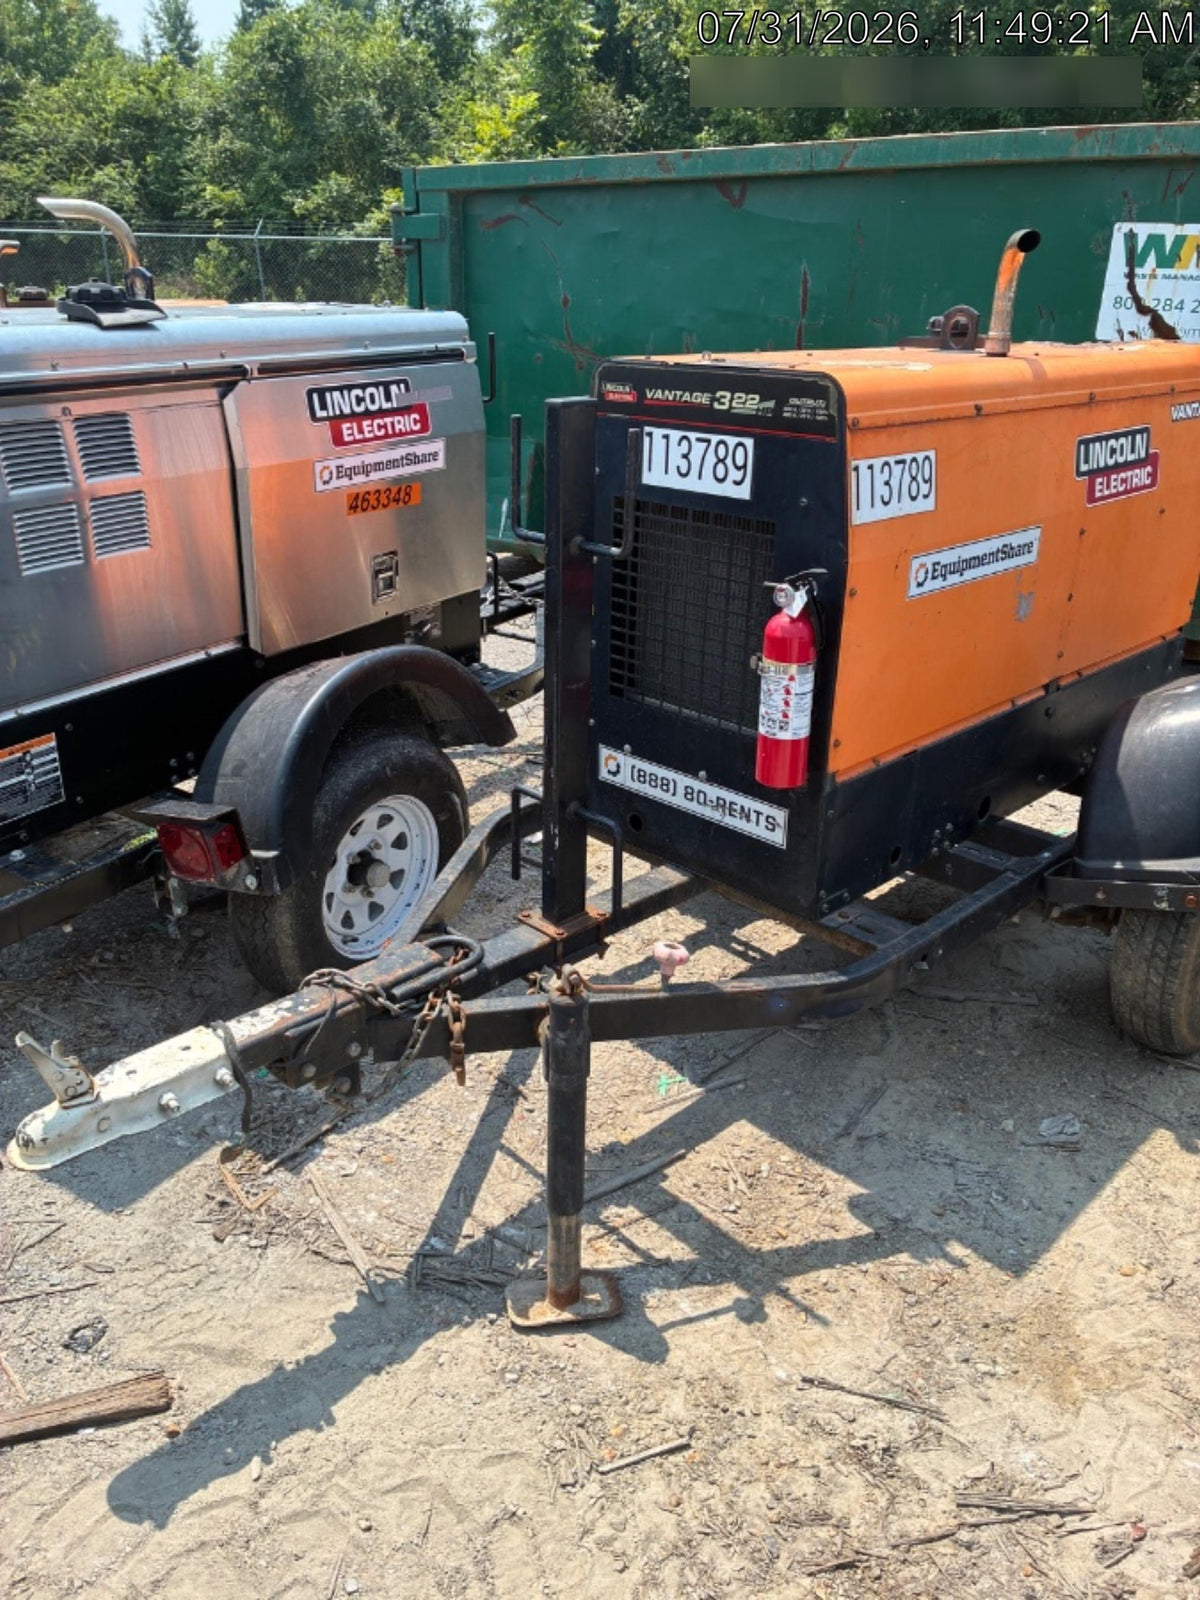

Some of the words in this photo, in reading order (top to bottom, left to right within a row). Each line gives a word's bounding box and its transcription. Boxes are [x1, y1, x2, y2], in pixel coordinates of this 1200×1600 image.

[312, 383, 406, 418] LINCOLN
[644, 387, 712, 405] VANTAGE
[712, 391, 760, 411] 322
[340, 413, 421, 443] ELECTRIC
[335, 449, 440, 481] EquipmentShare
[645, 431, 748, 487] 113789
[1080, 432, 1148, 473] LINCOLN
[347, 484, 413, 514] 463348
[852, 454, 933, 512] 113789
[1094, 465, 1153, 498] ELECTRIC
[930, 540, 1035, 582] EquipmentShare
[630, 764, 677, 798] (888)
[684, 784, 778, 834] 80-RENTS
